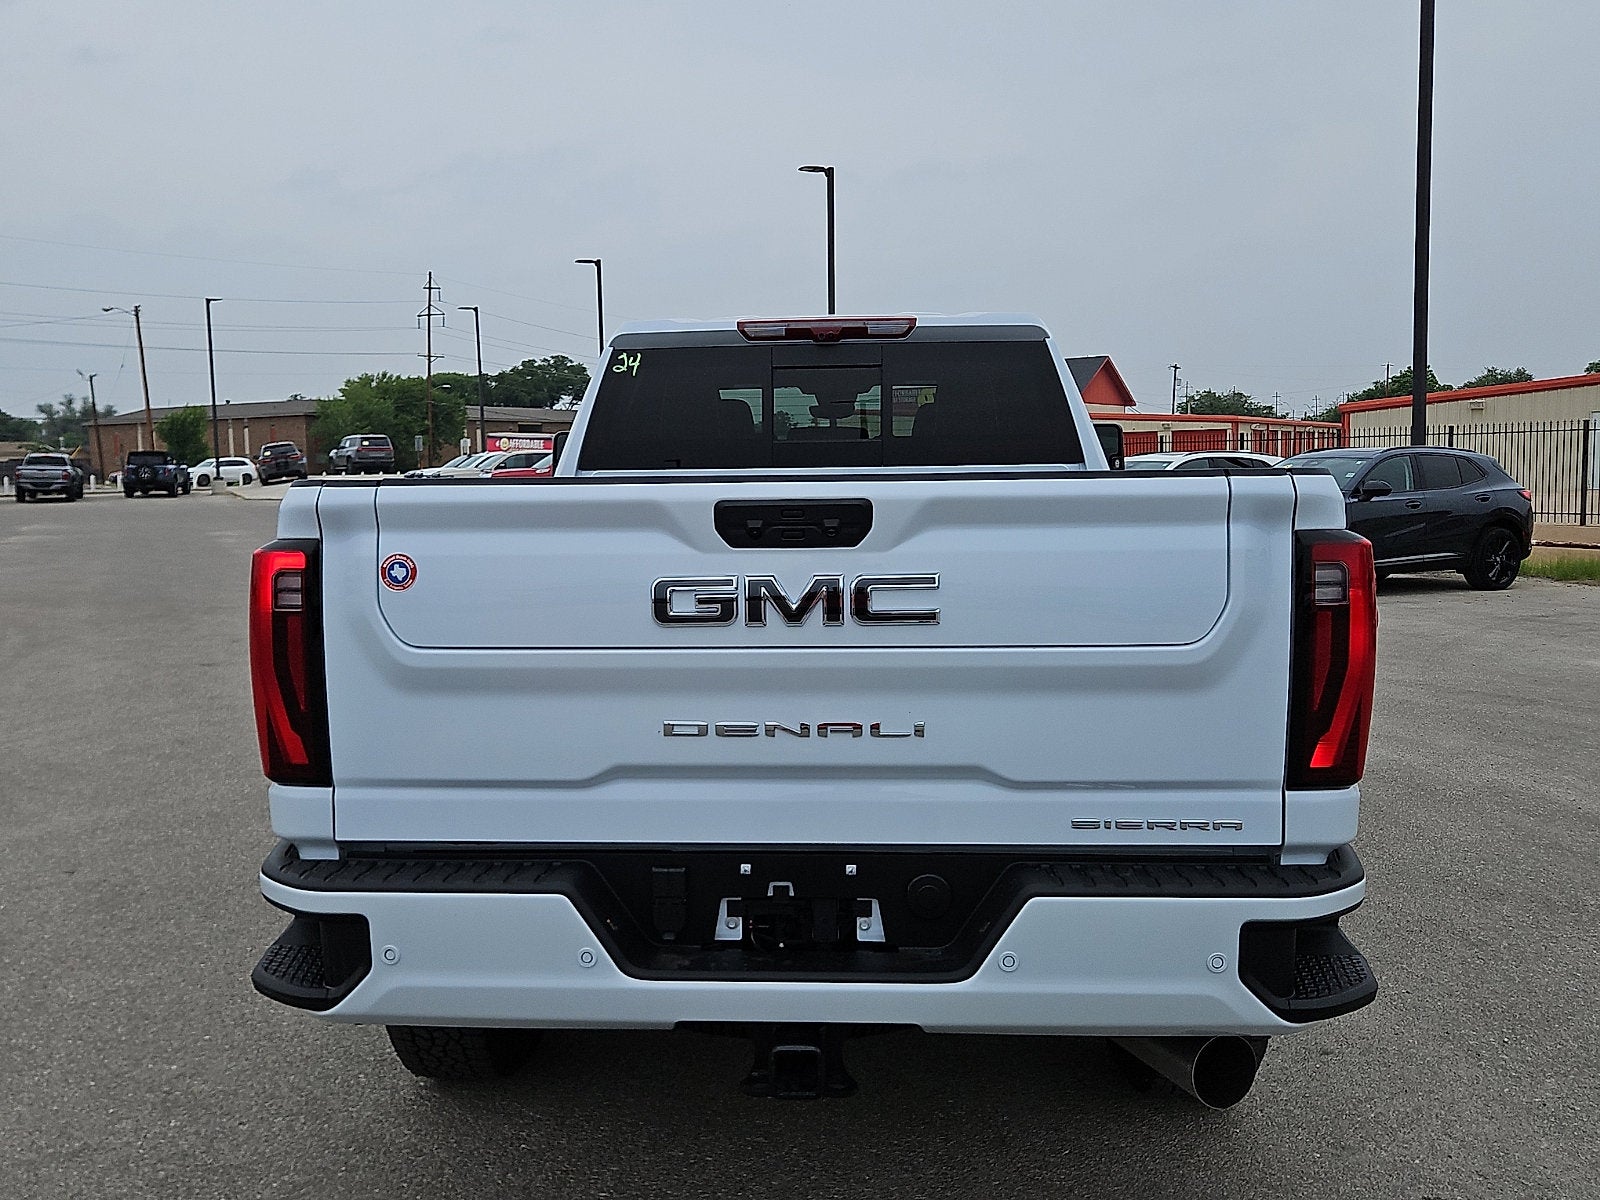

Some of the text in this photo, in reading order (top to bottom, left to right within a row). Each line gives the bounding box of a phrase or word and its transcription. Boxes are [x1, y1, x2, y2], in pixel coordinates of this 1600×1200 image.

[612, 352, 642, 377] 24
[510, 438, 545, 450] AFFORDABLE
[651, 572, 941, 627] GMC
[663, 720, 926, 738] DENALI
[1071, 817, 1243, 831] SIERRA
